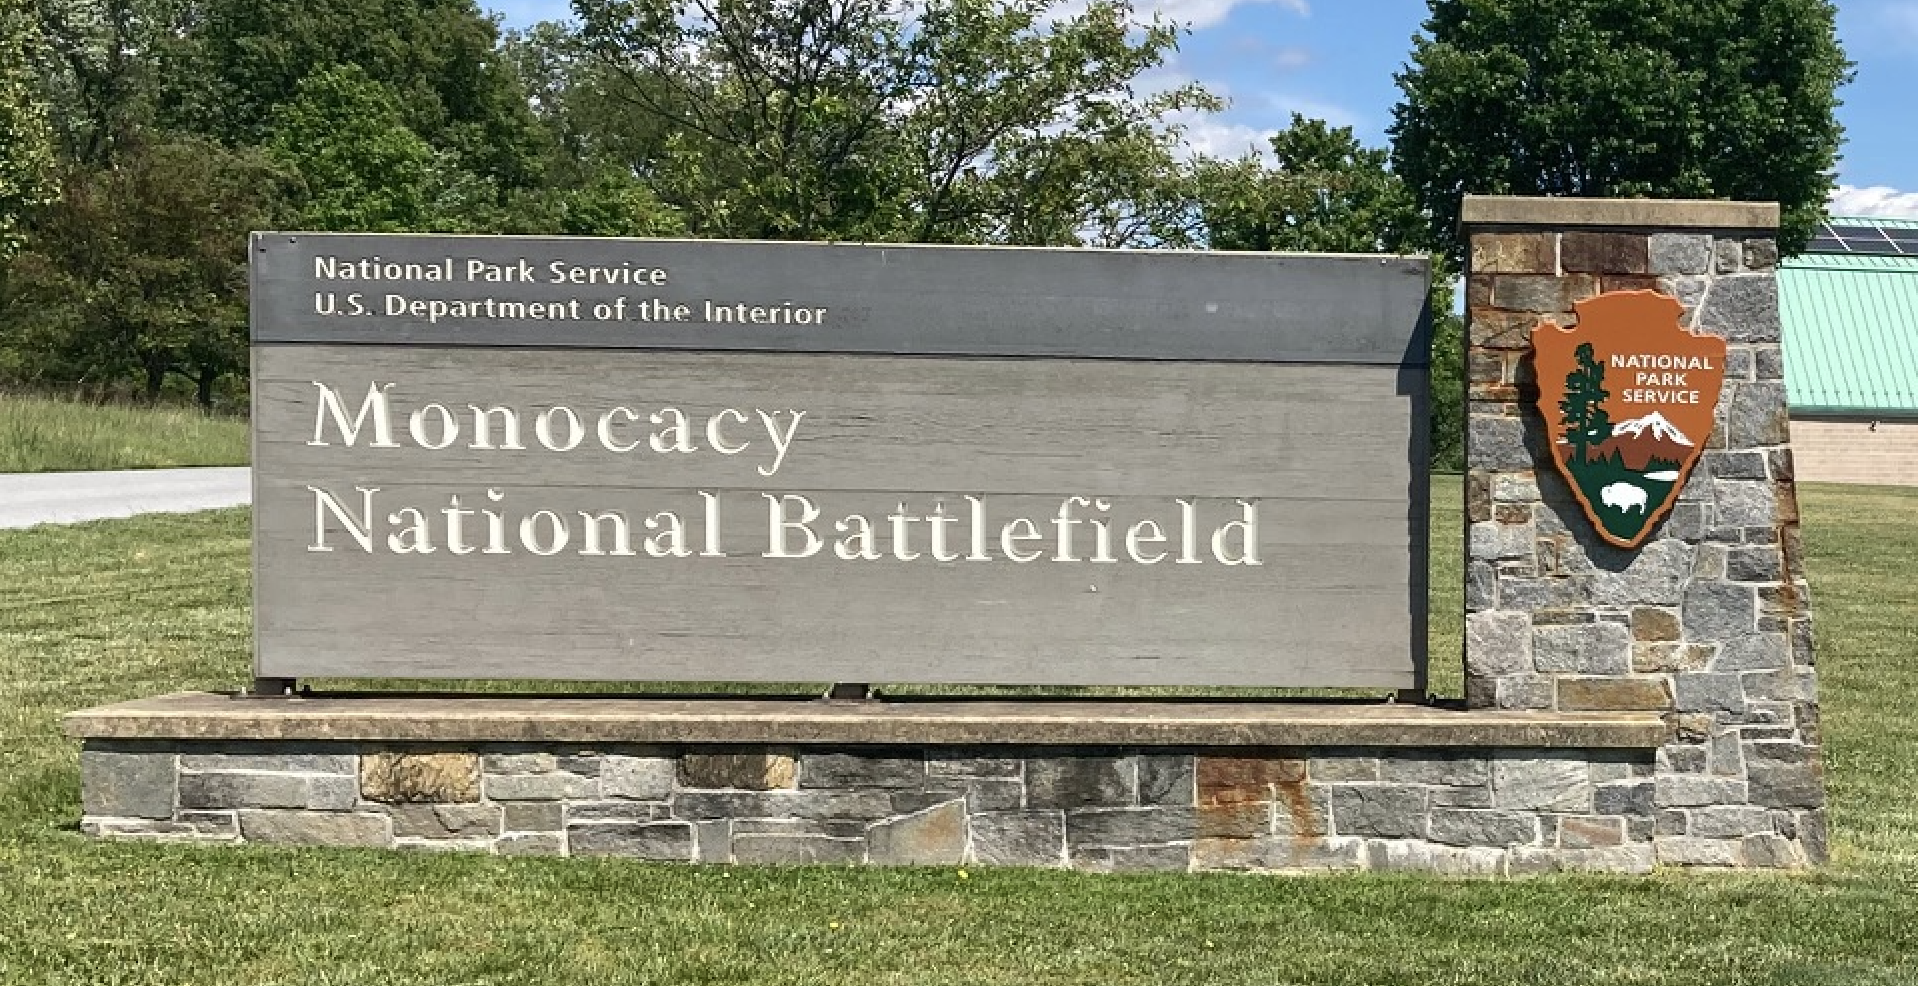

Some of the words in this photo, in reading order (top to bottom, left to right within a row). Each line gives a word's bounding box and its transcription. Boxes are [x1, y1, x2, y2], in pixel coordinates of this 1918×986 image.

[314, 256, 453, 282] National
[466, 259, 535, 283] Park
[549, 260, 668, 286] Service
[314, 292, 374, 317] U.S.
[385, 294, 581, 324] Department
[593, 299, 627, 321] of
[638, 301, 691, 322] the
[704, 301, 828, 325] Interior
[1610, 354, 1714, 370] NATIONAL
[1635, 372, 1687, 386] PARK
[1621, 389, 1700, 404] SERVICE
[306, 380, 807, 476] Monocacy
[306, 485, 727, 557] National
[761, 492, 1263, 566] Battlefield
